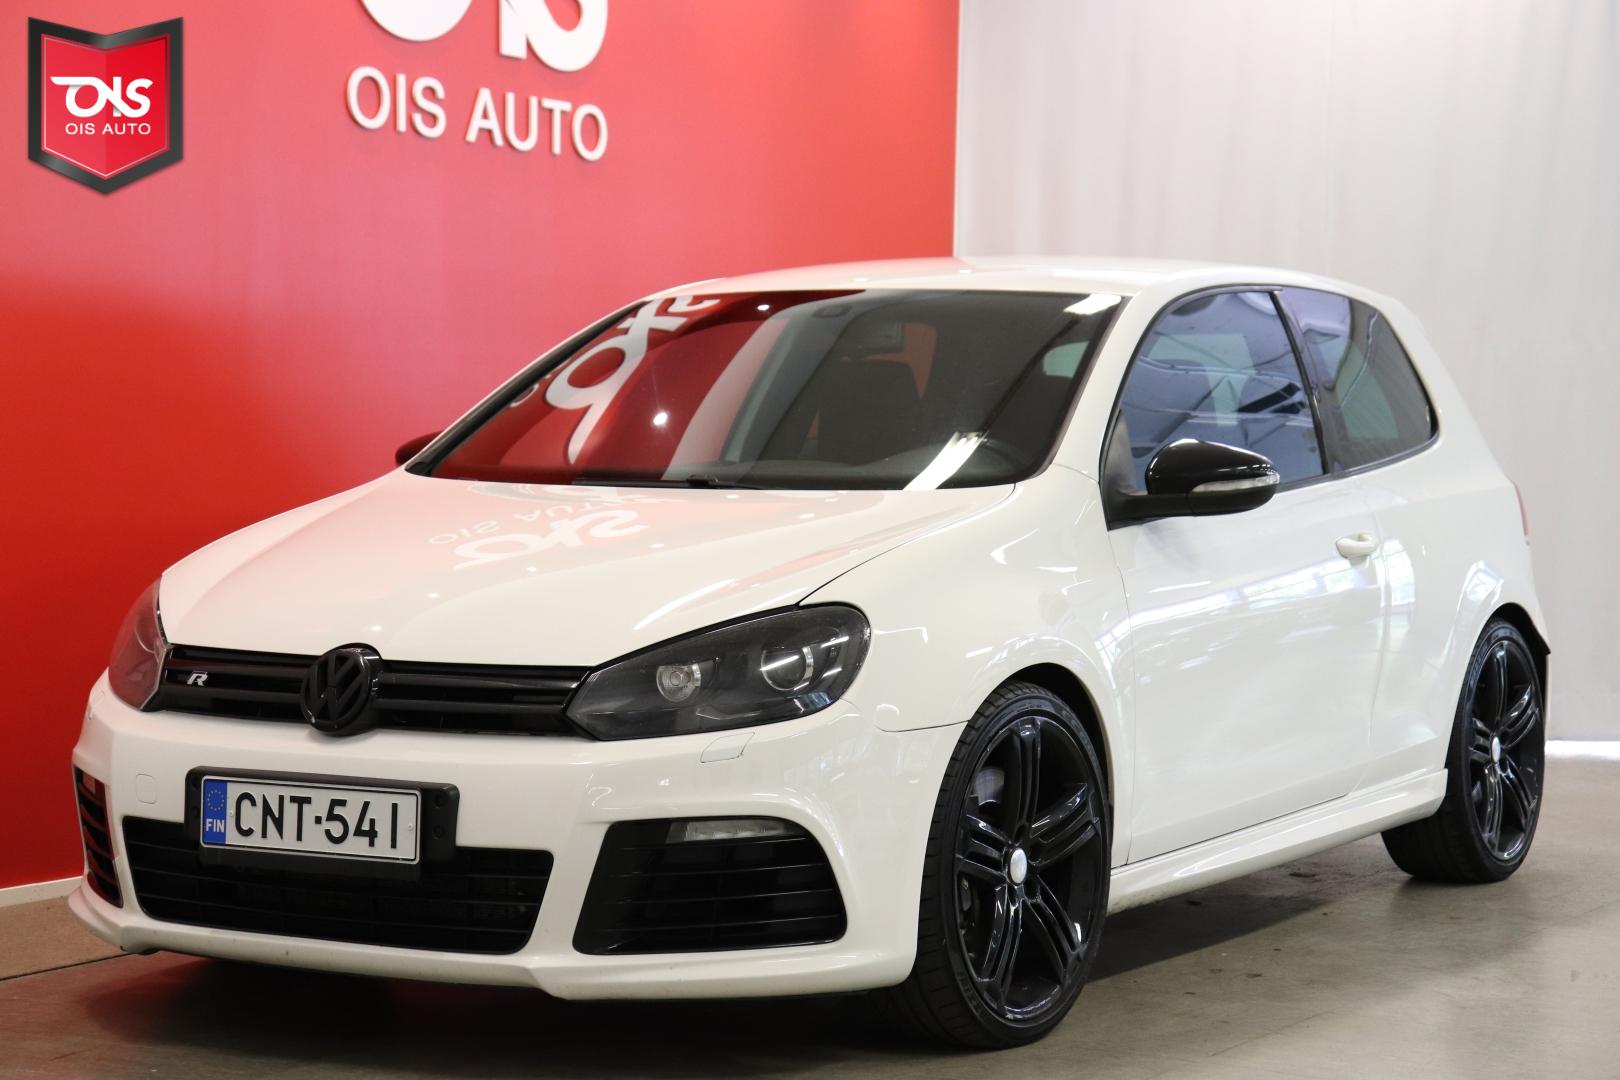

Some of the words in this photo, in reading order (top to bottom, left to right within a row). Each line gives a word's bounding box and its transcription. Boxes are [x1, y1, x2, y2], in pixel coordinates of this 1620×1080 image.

[346, 66, 447, 138] OIS
[465, 87, 608, 162] AUTO
[186, 670, 208, 687] R
[205, 818, 225, 833] FIN
